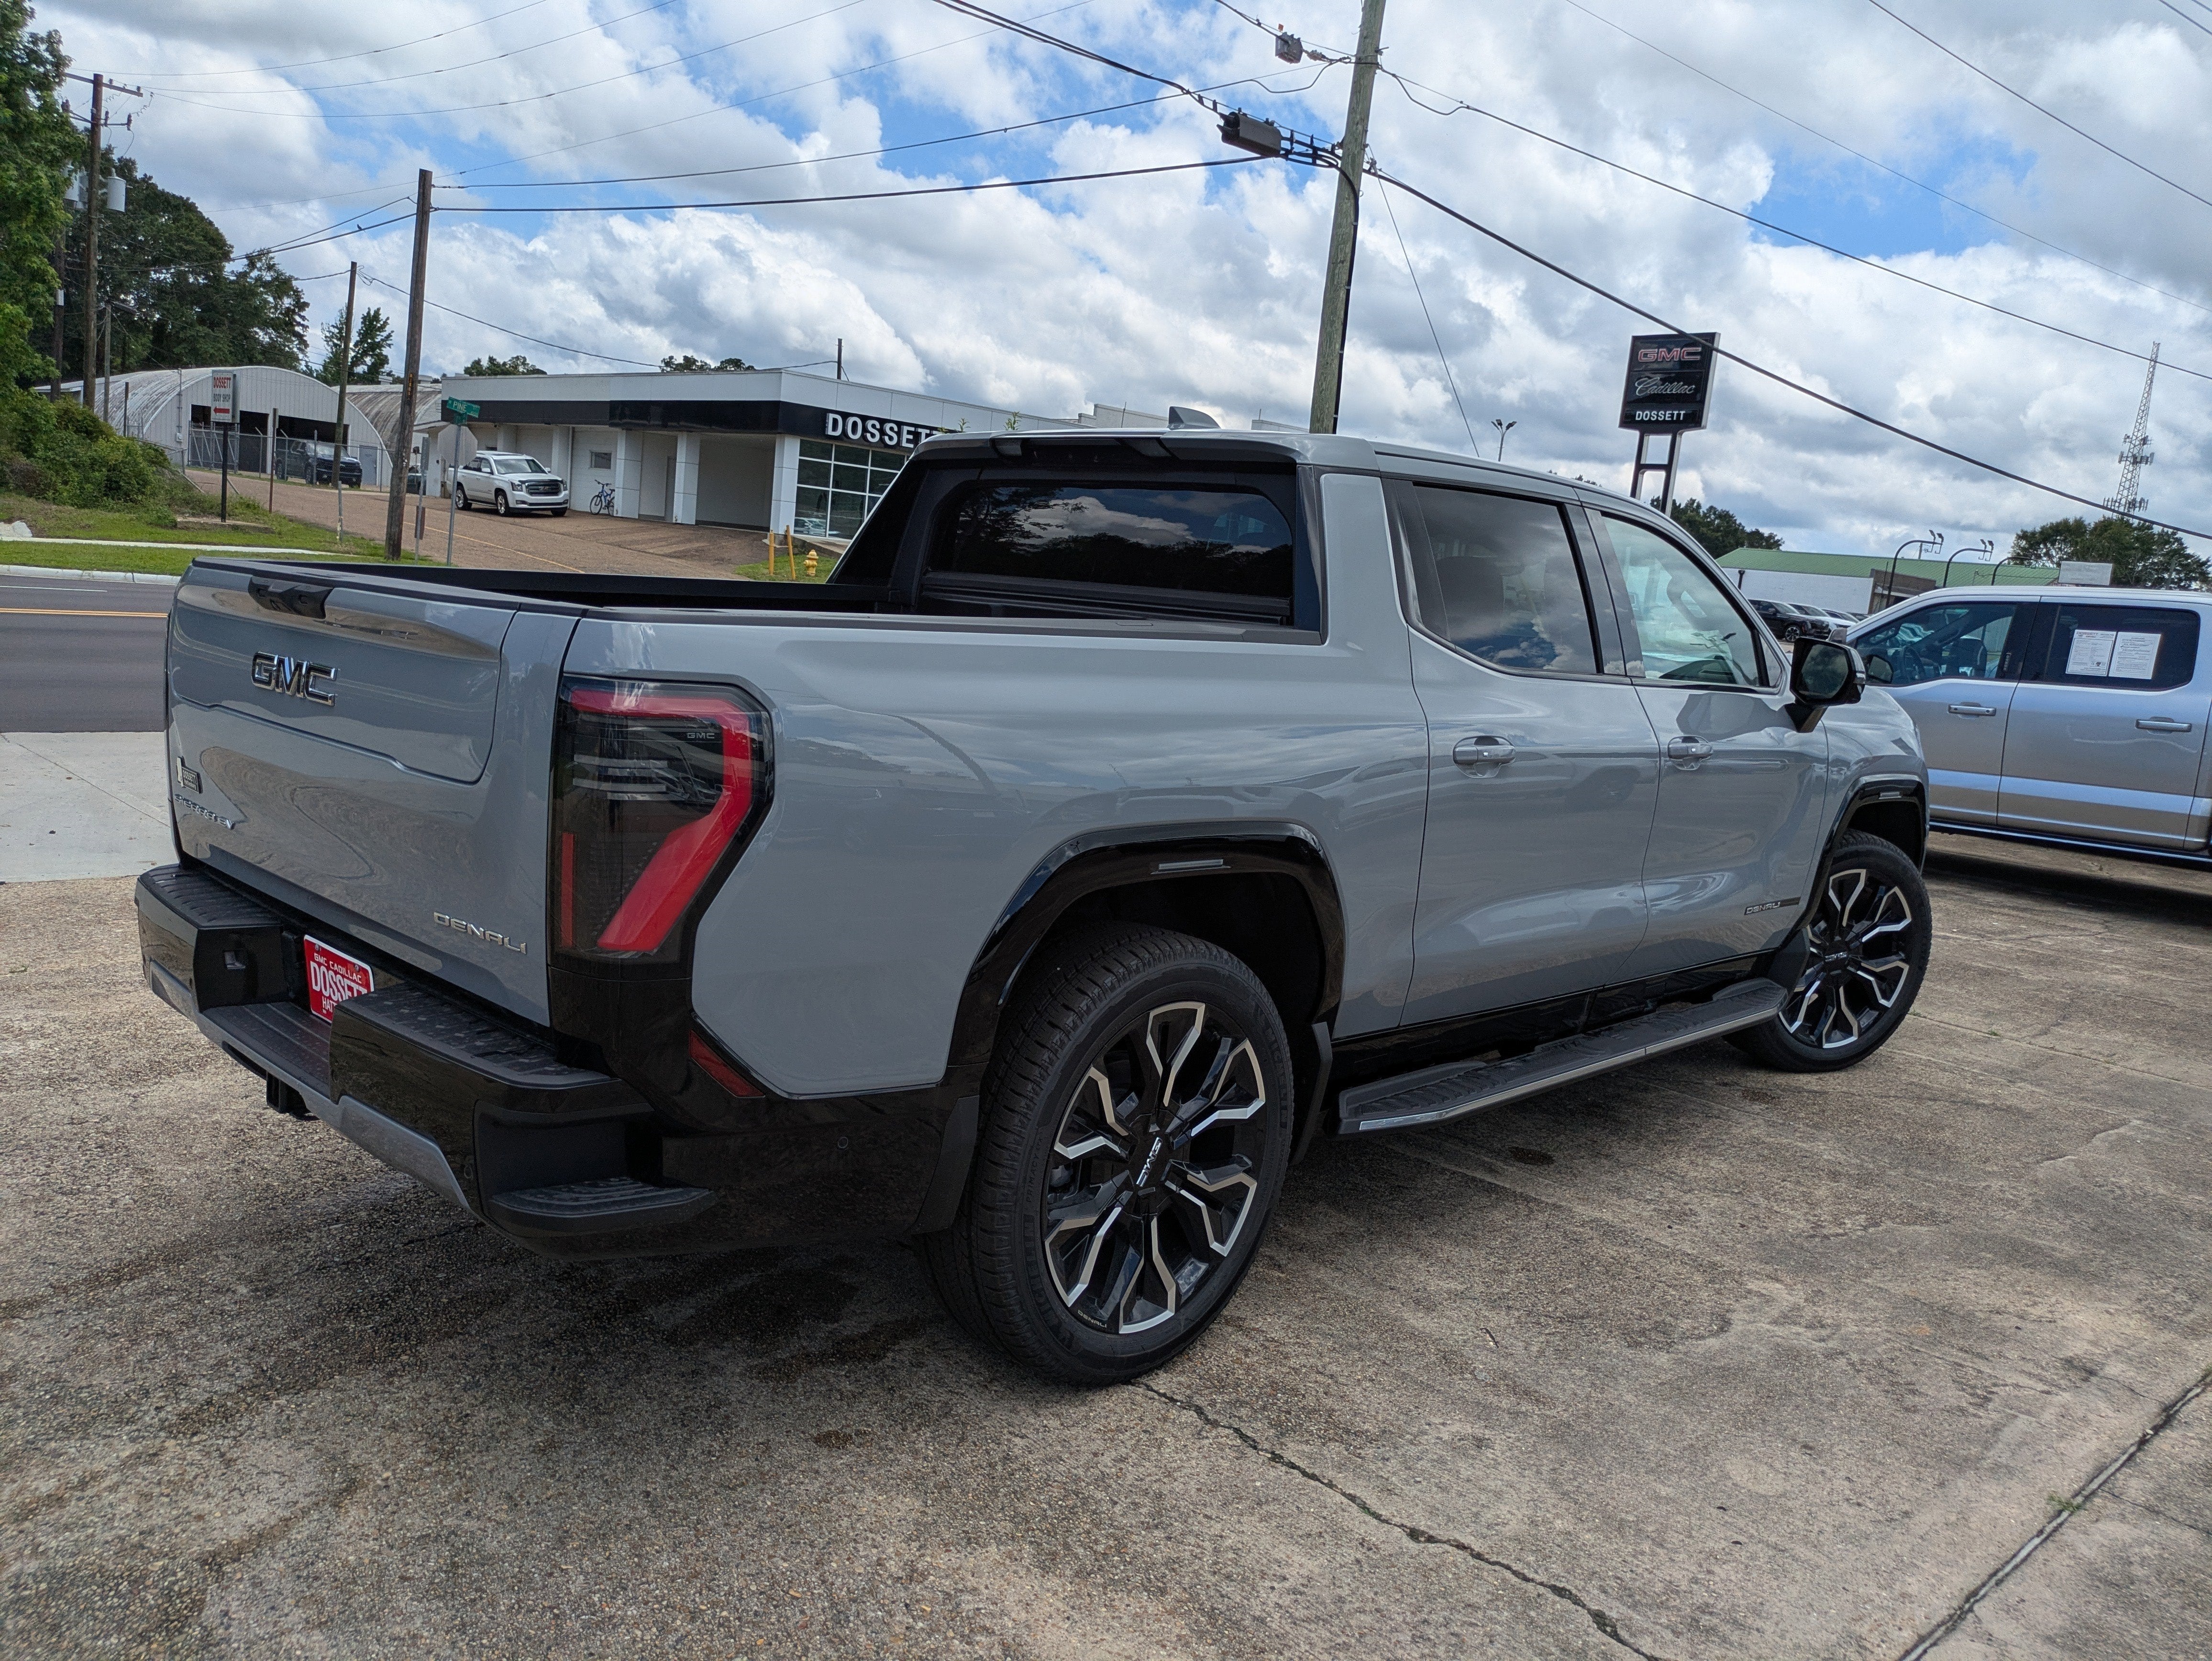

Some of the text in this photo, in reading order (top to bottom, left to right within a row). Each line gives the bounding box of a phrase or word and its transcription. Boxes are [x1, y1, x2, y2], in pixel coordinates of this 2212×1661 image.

[1638, 347, 1702, 362] GMC
[213, 376, 231, 388] DOSSETT
[1635, 376, 1696, 396] Cadillac
[453, 401, 467, 411] PINE
[1635, 410, 1685, 421] DOSSETT
[826, 413, 941, 448] DOSSET
[252, 651, 339, 707] GMC
[175, 794, 235, 830] SIERRA EV
[1747, 902, 1781, 914] DENALI
[434, 912, 527, 954] DENALI
[314, 952, 362, 984] GMC CADILLAC
[1136, 1137, 1163, 1187] GMC
[1078, 1309, 1107, 1328] DENALI
